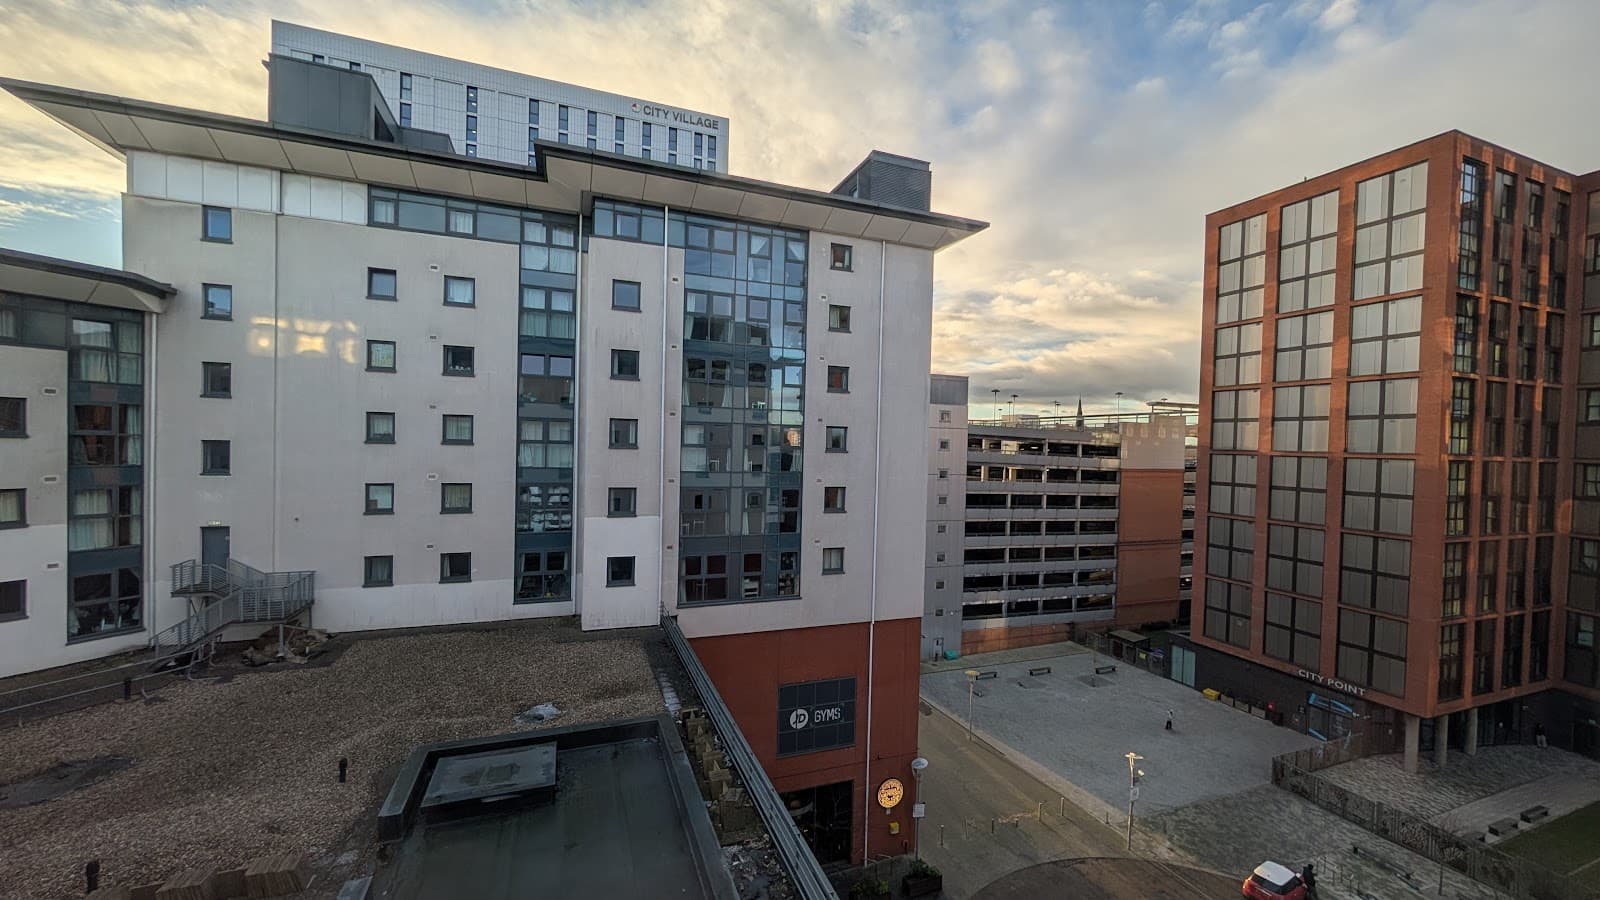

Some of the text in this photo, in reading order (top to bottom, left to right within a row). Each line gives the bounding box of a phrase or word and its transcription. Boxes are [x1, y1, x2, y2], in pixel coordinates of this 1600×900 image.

[643, 105, 719, 130] CITY VILLAGE
[1298, 669, 1366, 696] CITY POINT
[790, 707, 841, 729] JD GYMS
